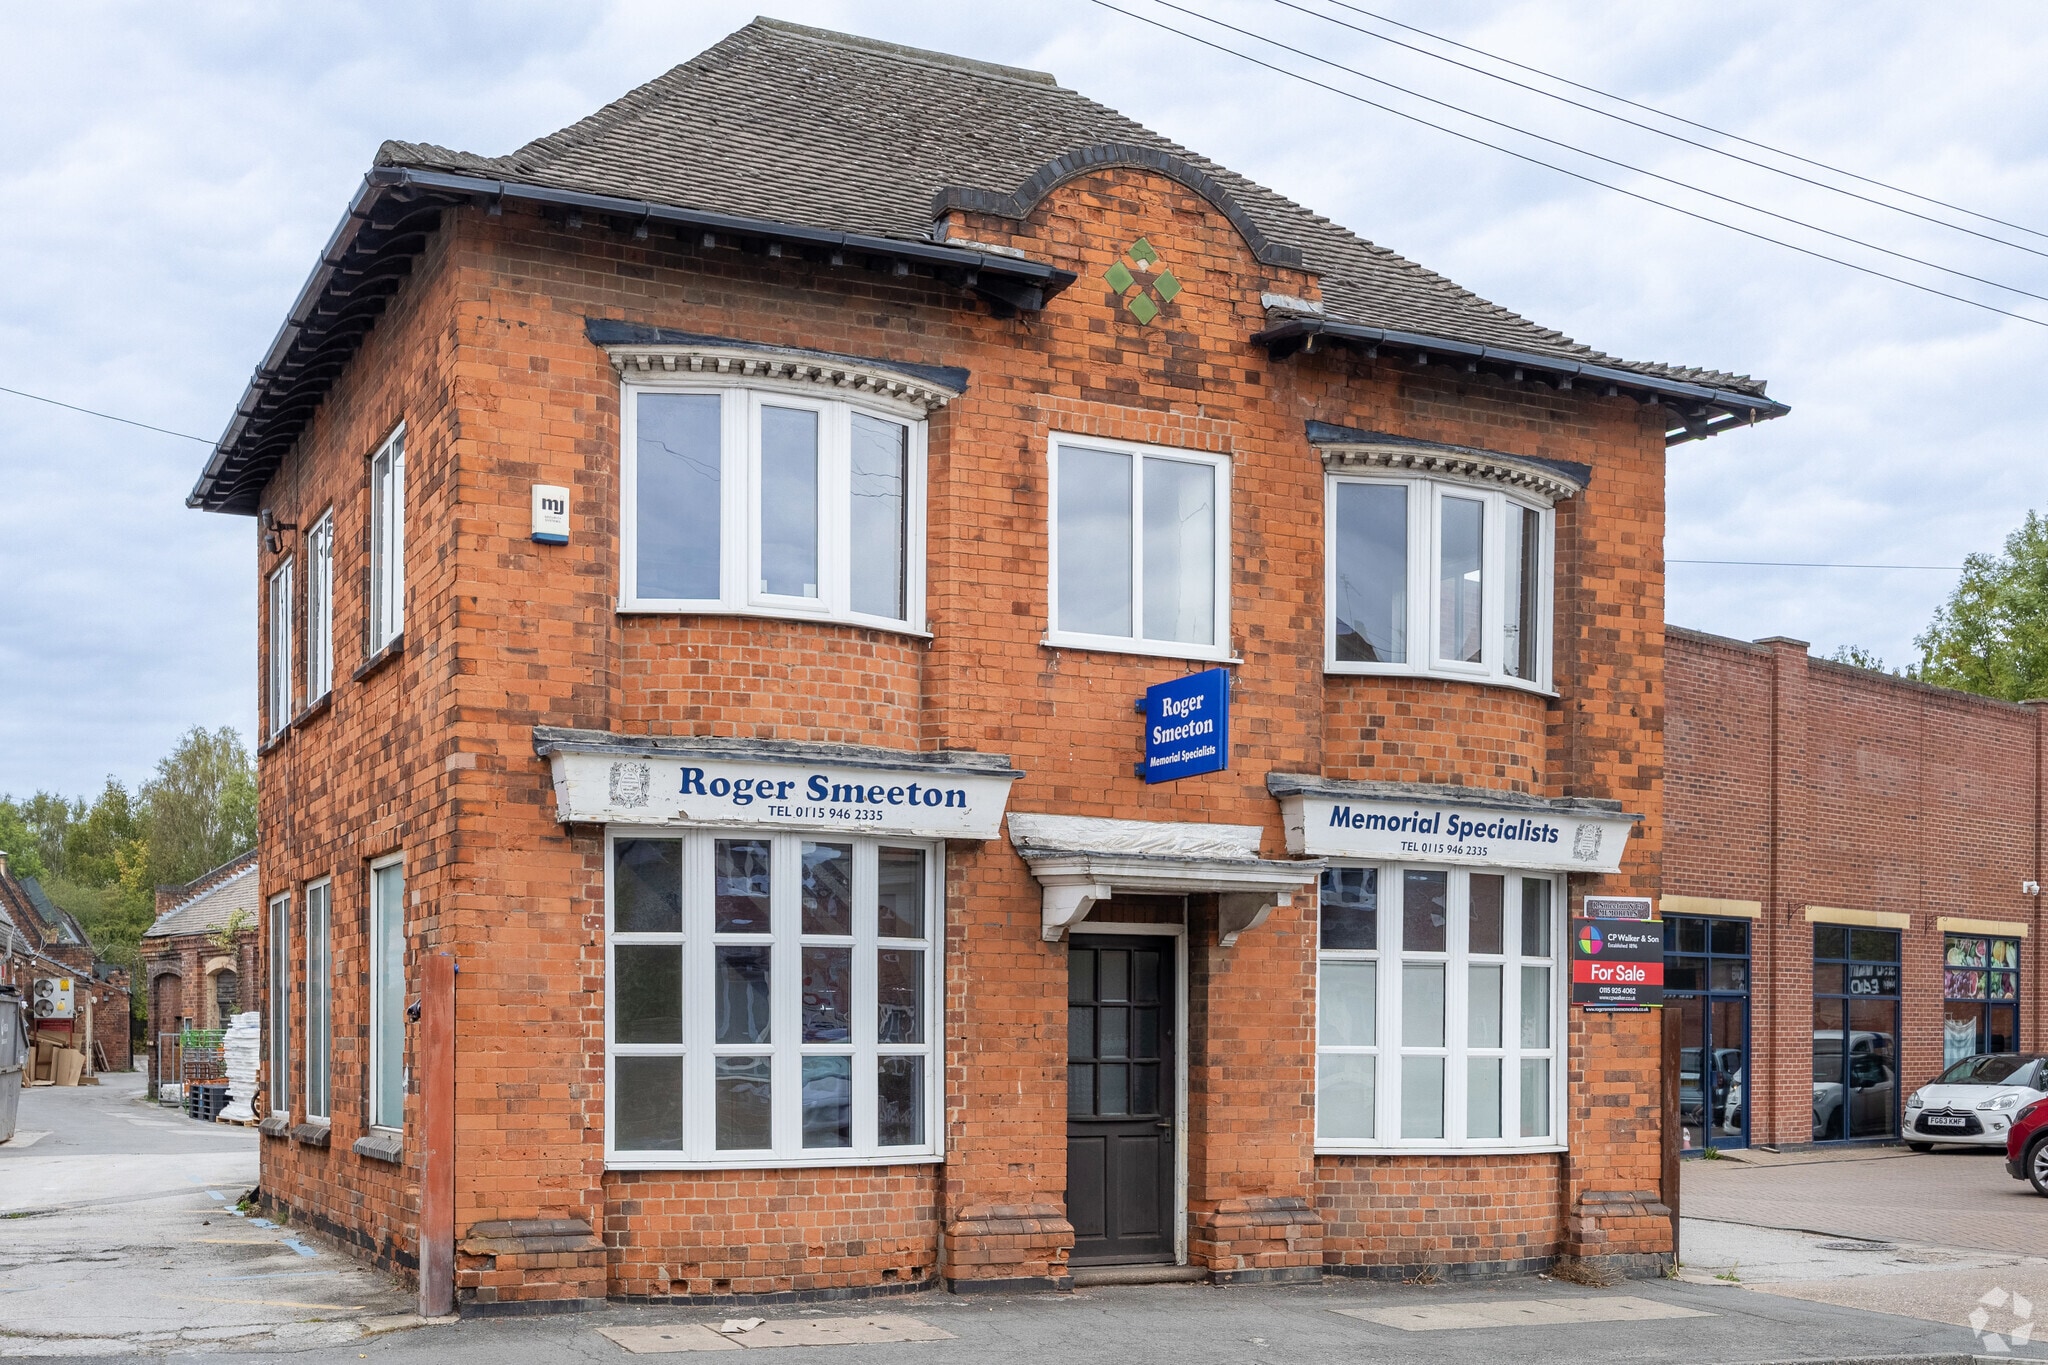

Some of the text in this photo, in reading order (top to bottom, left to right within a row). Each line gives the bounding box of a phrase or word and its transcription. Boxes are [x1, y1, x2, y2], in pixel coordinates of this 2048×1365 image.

[542, 497, 564, 515] mj
[1162, 694, 1204, 718] Roger
[1152, 718, 1213, 745] Smeeton
[1150, 745, 1215, 767] Memorial Specialists
[678, 767, 796, 805] Roger
[806, 774, 967, 809] Smeeton
[768, 805, 883, 822] TEL 0115 946 2335
[1329, 805, 1440, 834] Memorial
[1446, 813, 1559, 843] Specialists
[1401, 841, 1488, 857] TEL 0115 946 2335
[1598, 909, 1639, 917] MEMORIALS
[1607, 933, 1659, 943] CP Walker & Son
[1591, 963, 1646, 982] For Sale
[1599, 986, 1611, 994] 0115
[1930, 1117, 1948, 1125] FG63
